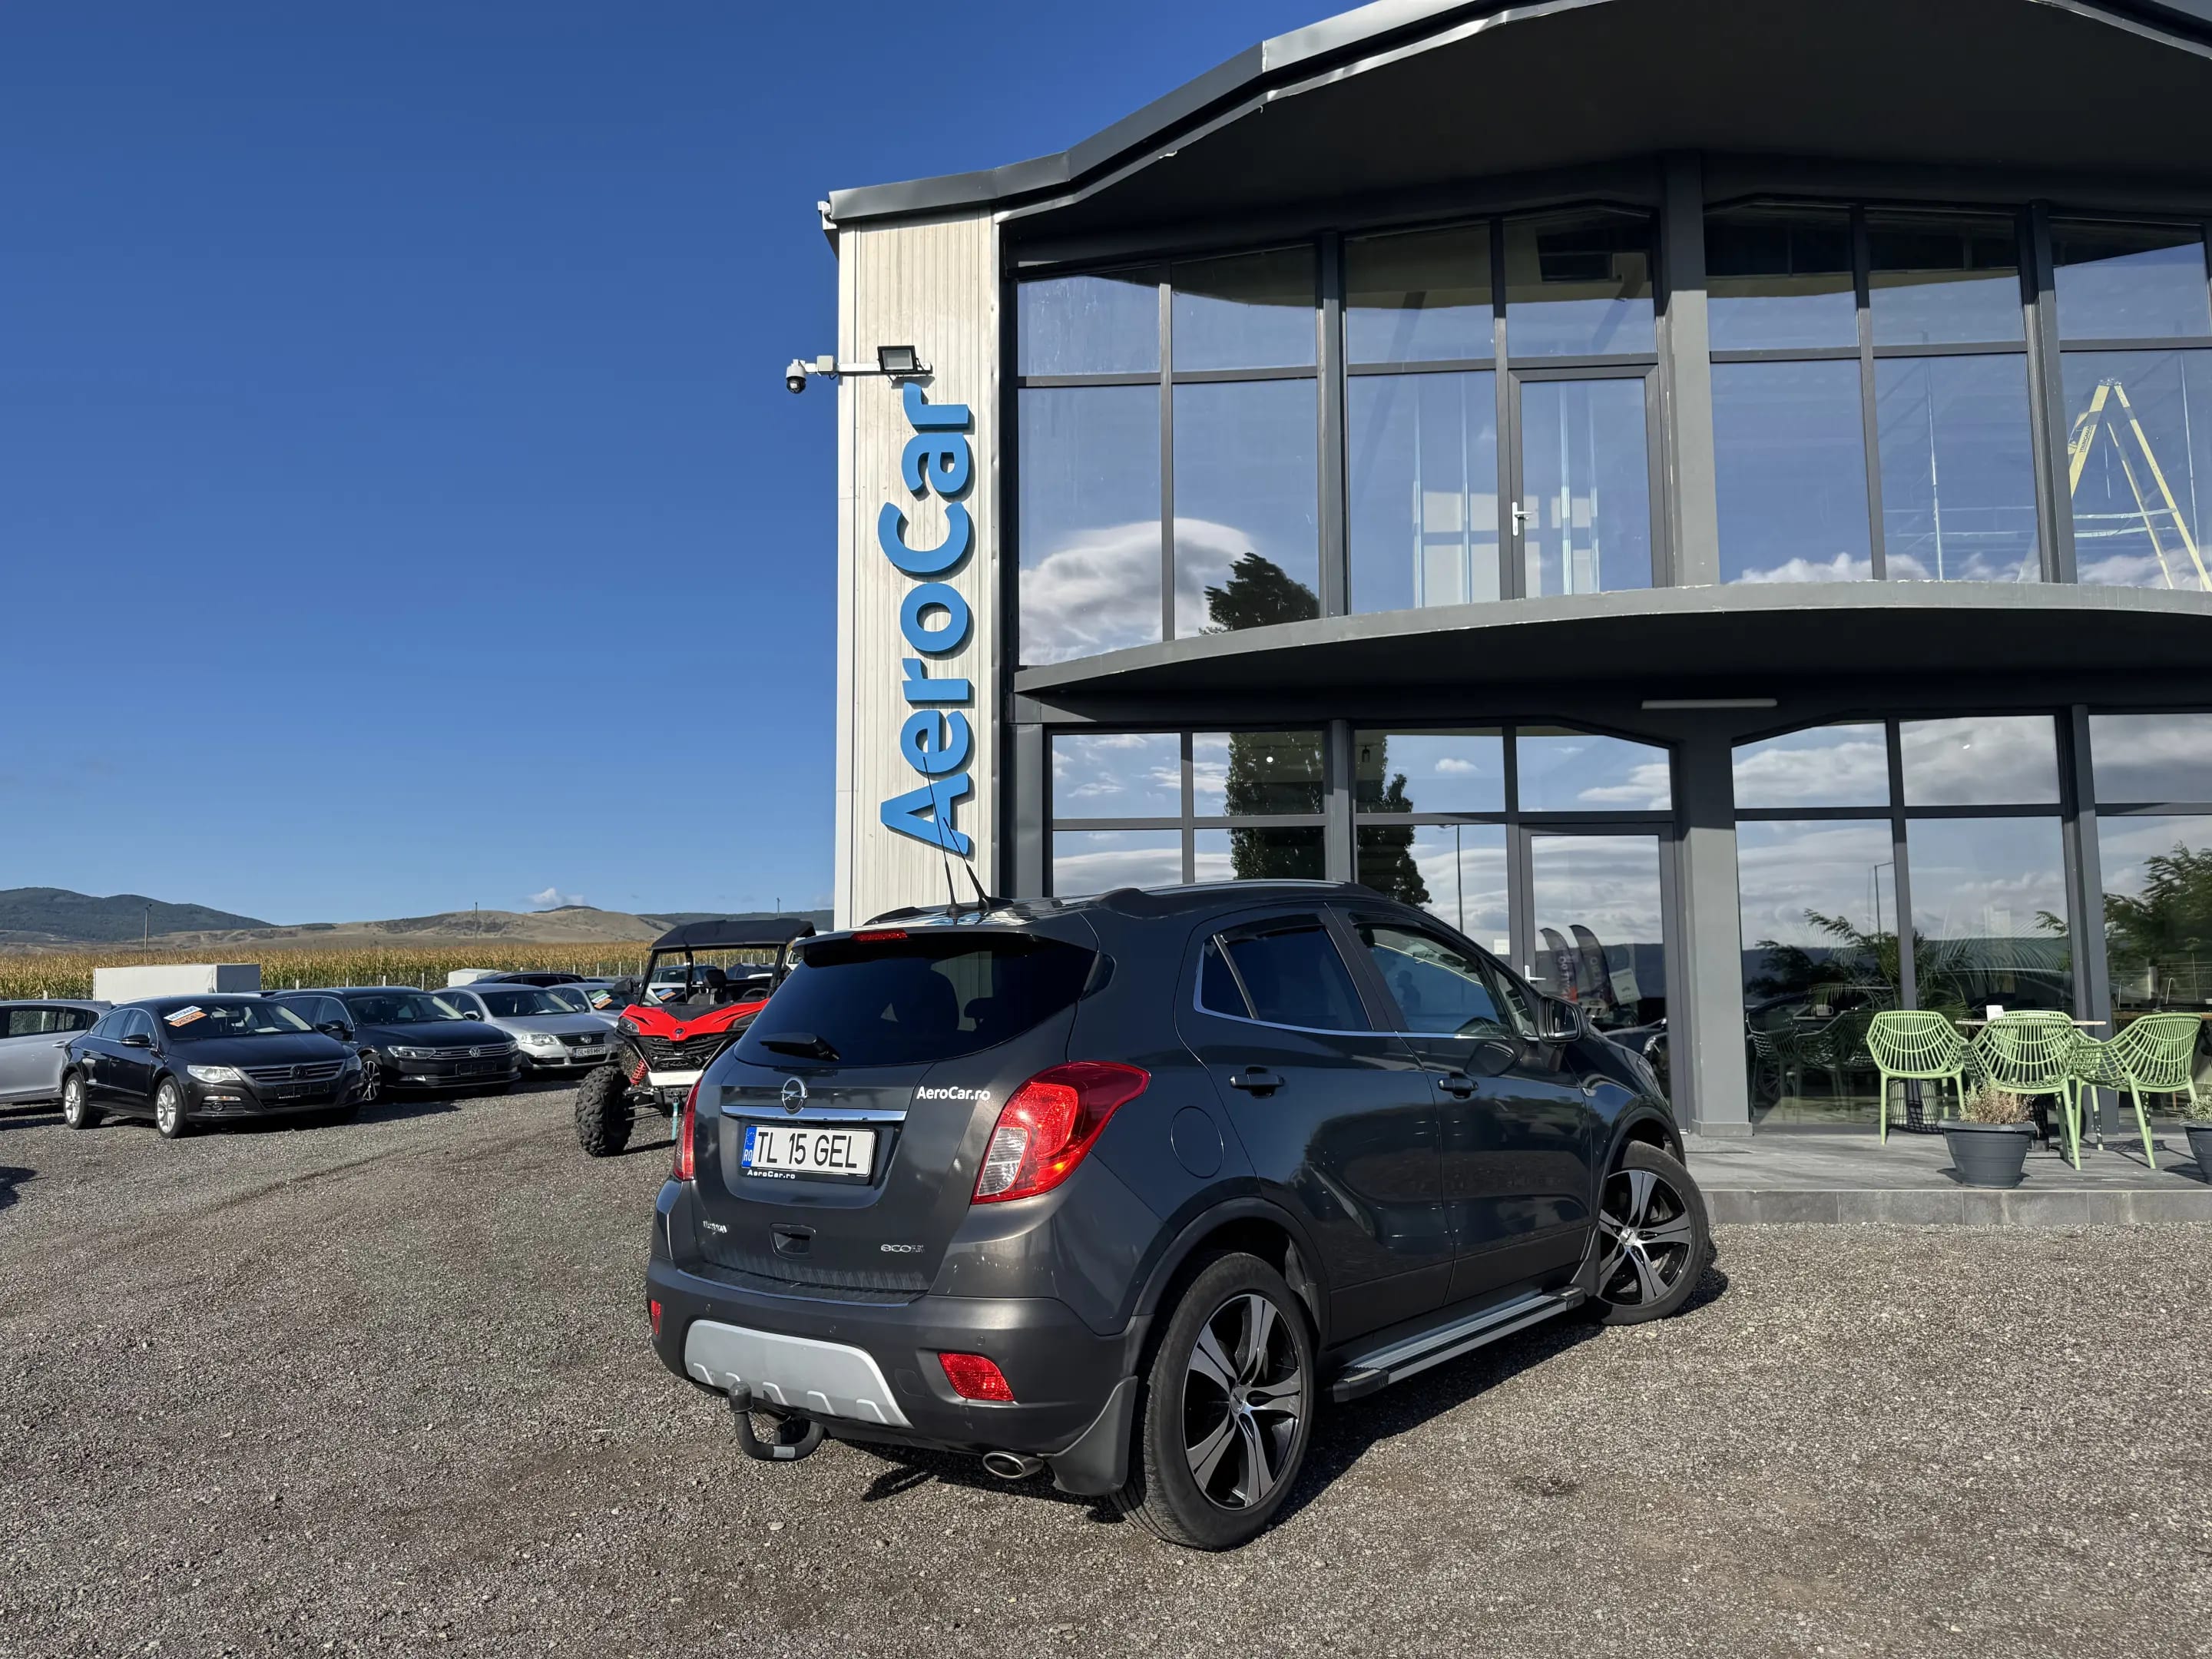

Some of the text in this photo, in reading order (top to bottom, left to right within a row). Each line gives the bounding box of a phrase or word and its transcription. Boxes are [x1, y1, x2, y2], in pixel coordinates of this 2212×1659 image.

[877, 381, 969, 856] AeroCar
[916, 1086, 991, 1101] AeroCar.ro
[758, 1132, 857, 1168] TL 15 GEL
[747, 1170, 796, 1180] AeroCar.ro
